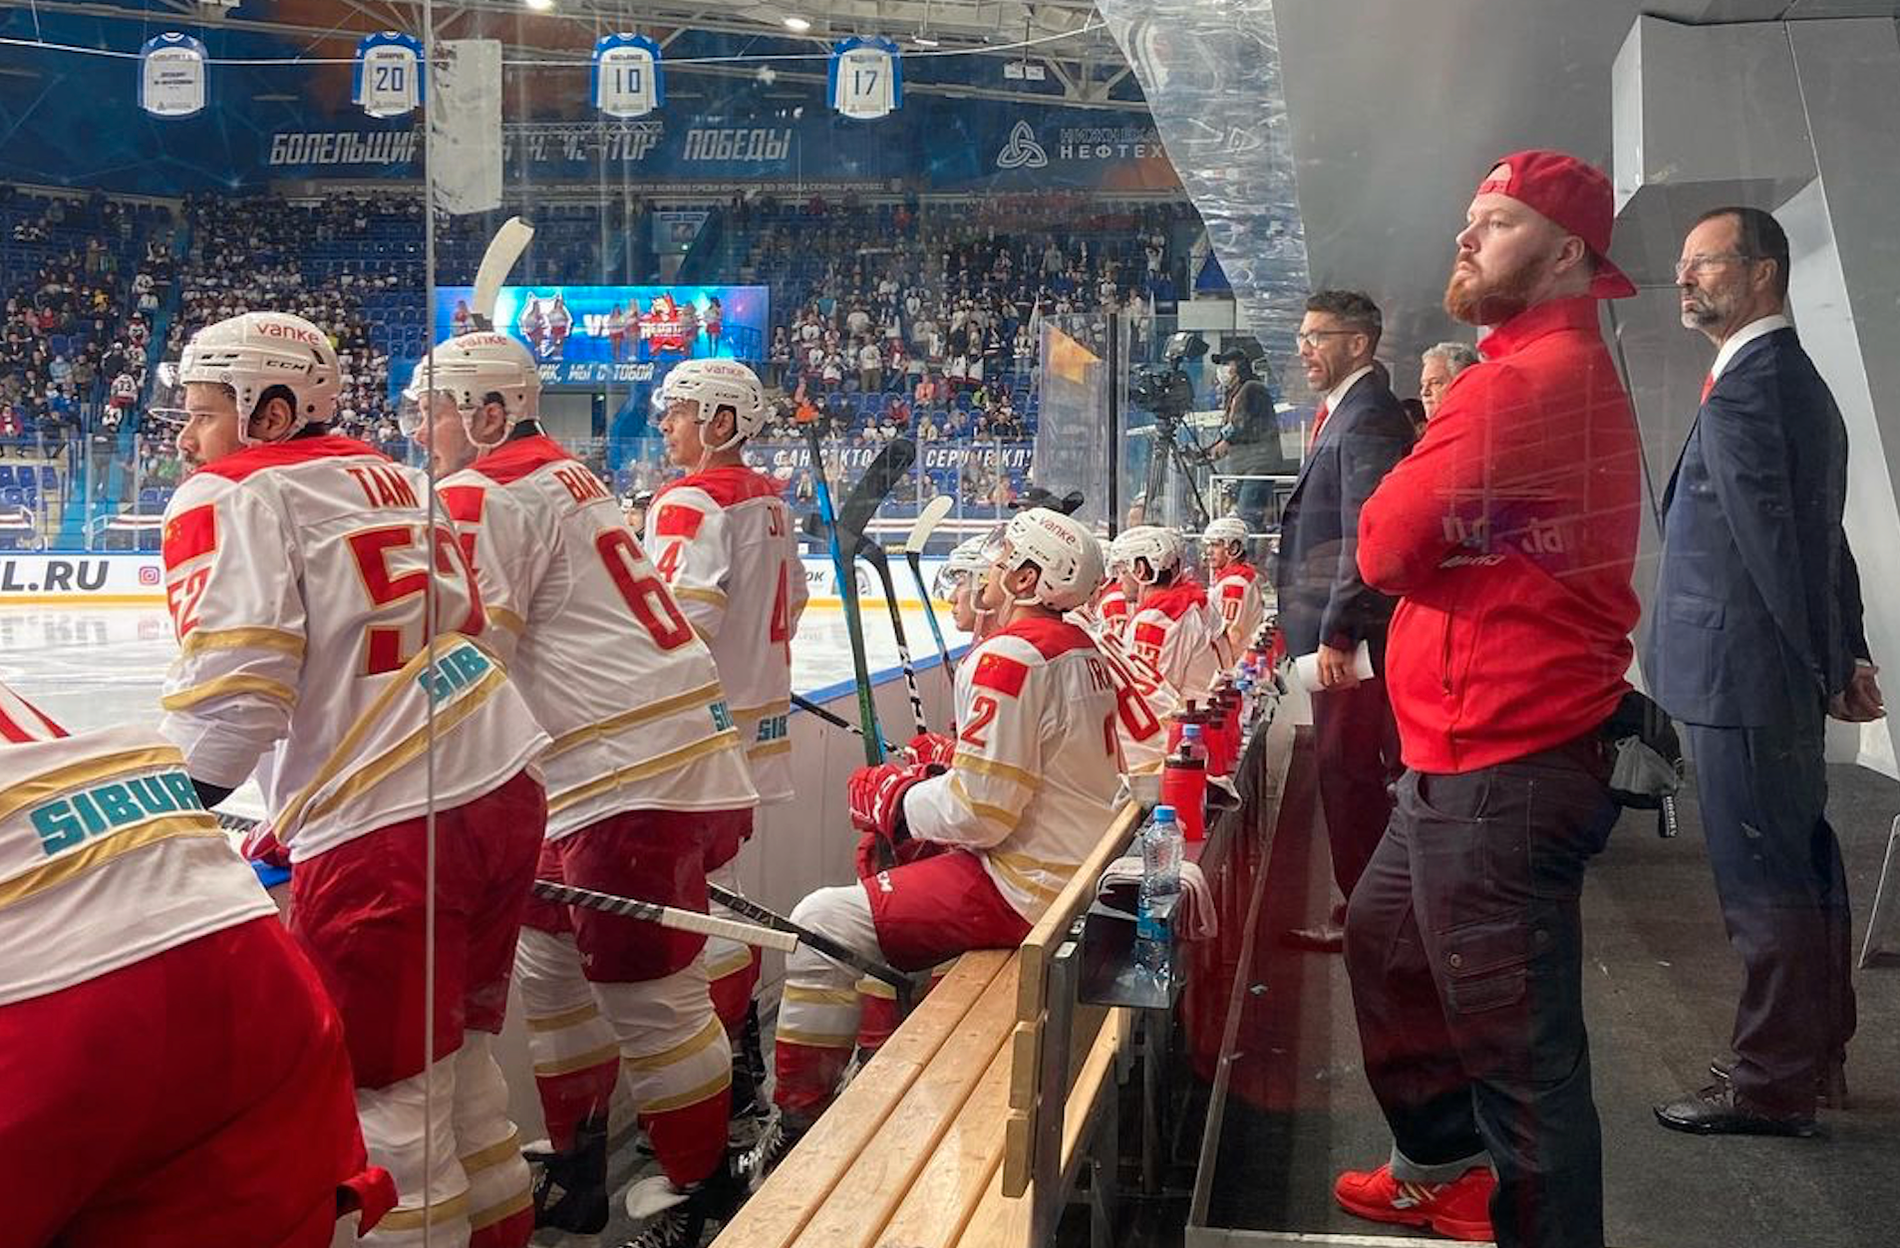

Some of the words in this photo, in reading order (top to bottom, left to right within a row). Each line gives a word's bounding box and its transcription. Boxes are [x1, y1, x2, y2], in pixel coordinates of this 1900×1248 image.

[375, 67, 404, 92] 20
[616, 68, 640, 93] 10
[855, 70, 878, 96] 17
[683, 128, 792, 161] ПОБЕДЫ
[1060, 144, 1163, 159] НЕФТЕХ
[256, 323, 320, 345] vanke
[455, 335, 507, 348] vanke
[266, 360, 305, 370] CCM
[568, 363, 592, 381] МЫ
[613, 362, 655, 381] ТОБОЙ
[1039, 517, 1076, 545] vanke
[656, 541, 684, 583] 4
[0, 561, 109, 591] L.RU
[595, 527, 694, 651] 6
[960, 696, 997, 749] 2
[30, 771, 204, 856] SIBUR
